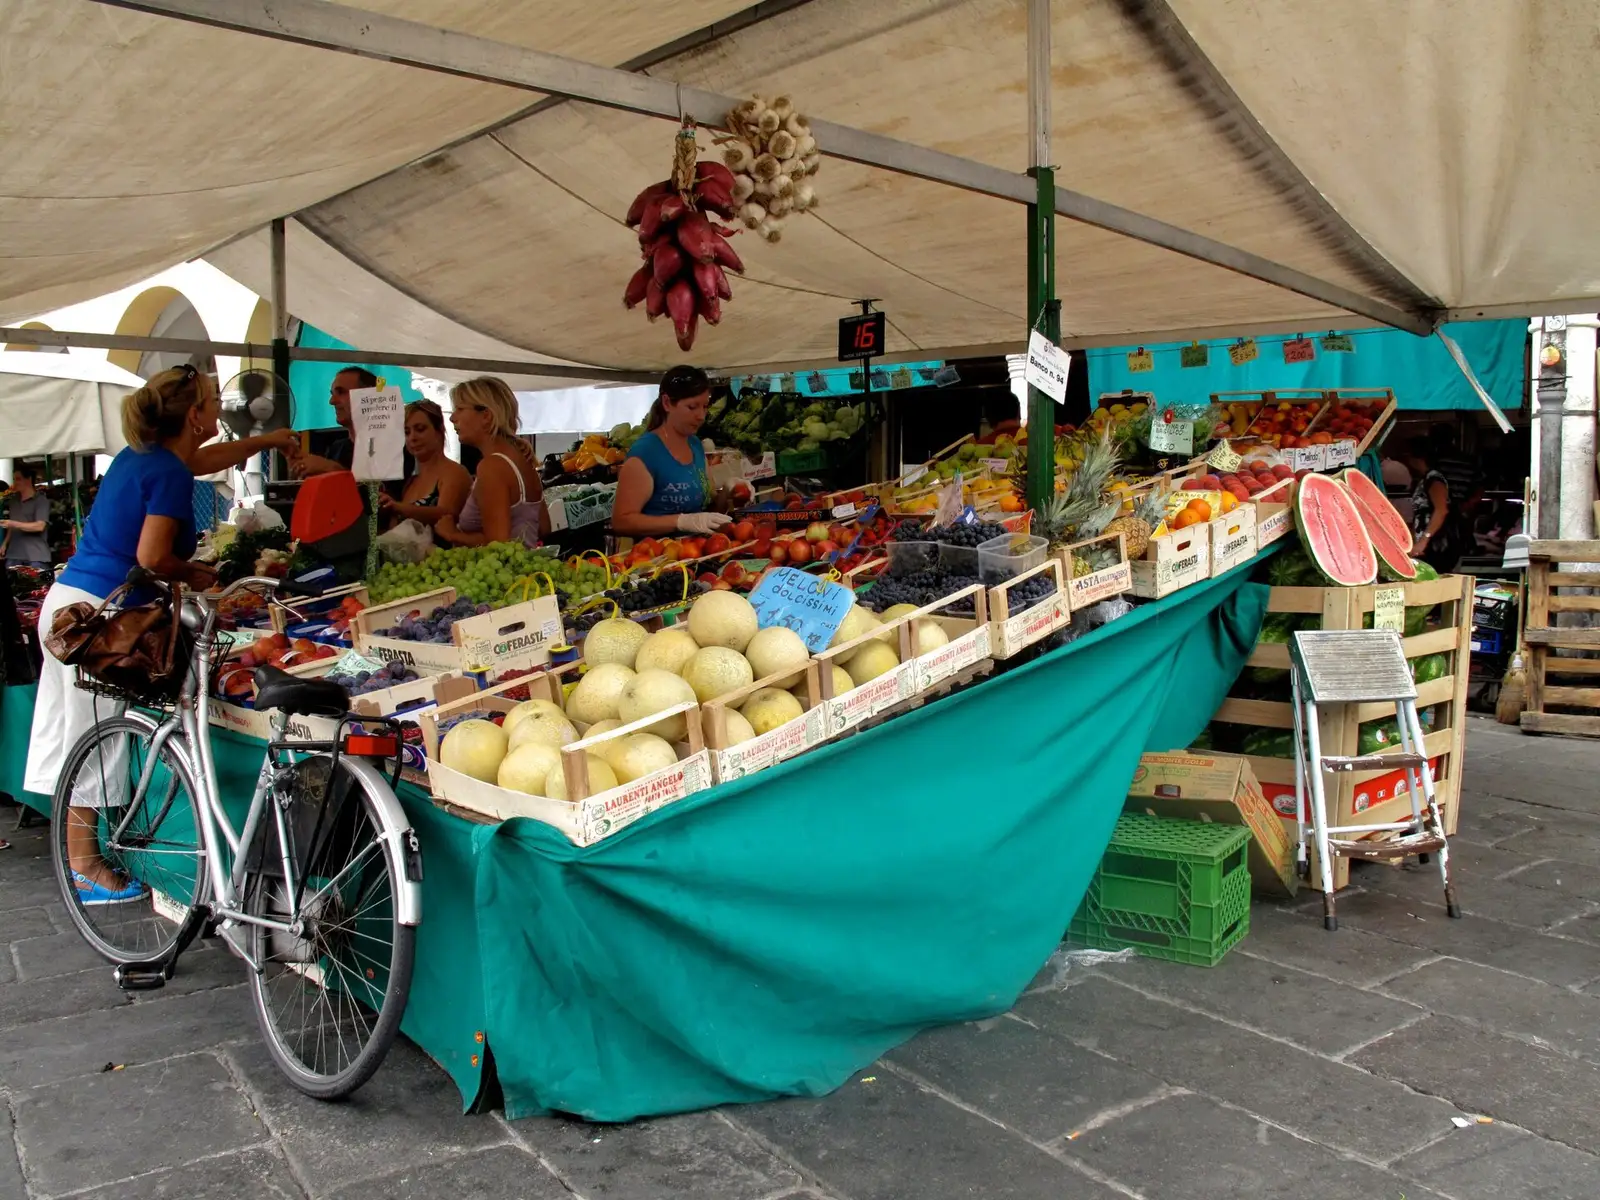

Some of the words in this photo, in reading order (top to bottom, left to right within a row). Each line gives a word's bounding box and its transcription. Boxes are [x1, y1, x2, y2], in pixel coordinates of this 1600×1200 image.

[854, 321, 876, 347] 16
[1030, 355, 1048, 374] Banco
[1056, 374, 1064, 385] 94
[388, 394, 397, 402] di
[391, 403, 397, 411] il
[773, 568, 841, 600] MELONI
[844, 690, 874, 710] LAURENTI
[875, 677, 898, 696] ANGELO
[742, 738, 778, 760] LAURENTI
[780, 723, 806, 743] ANGELO
[604, 786, 648, 812] LAURENTI
[651, 771, 685, 793] ANGELO
